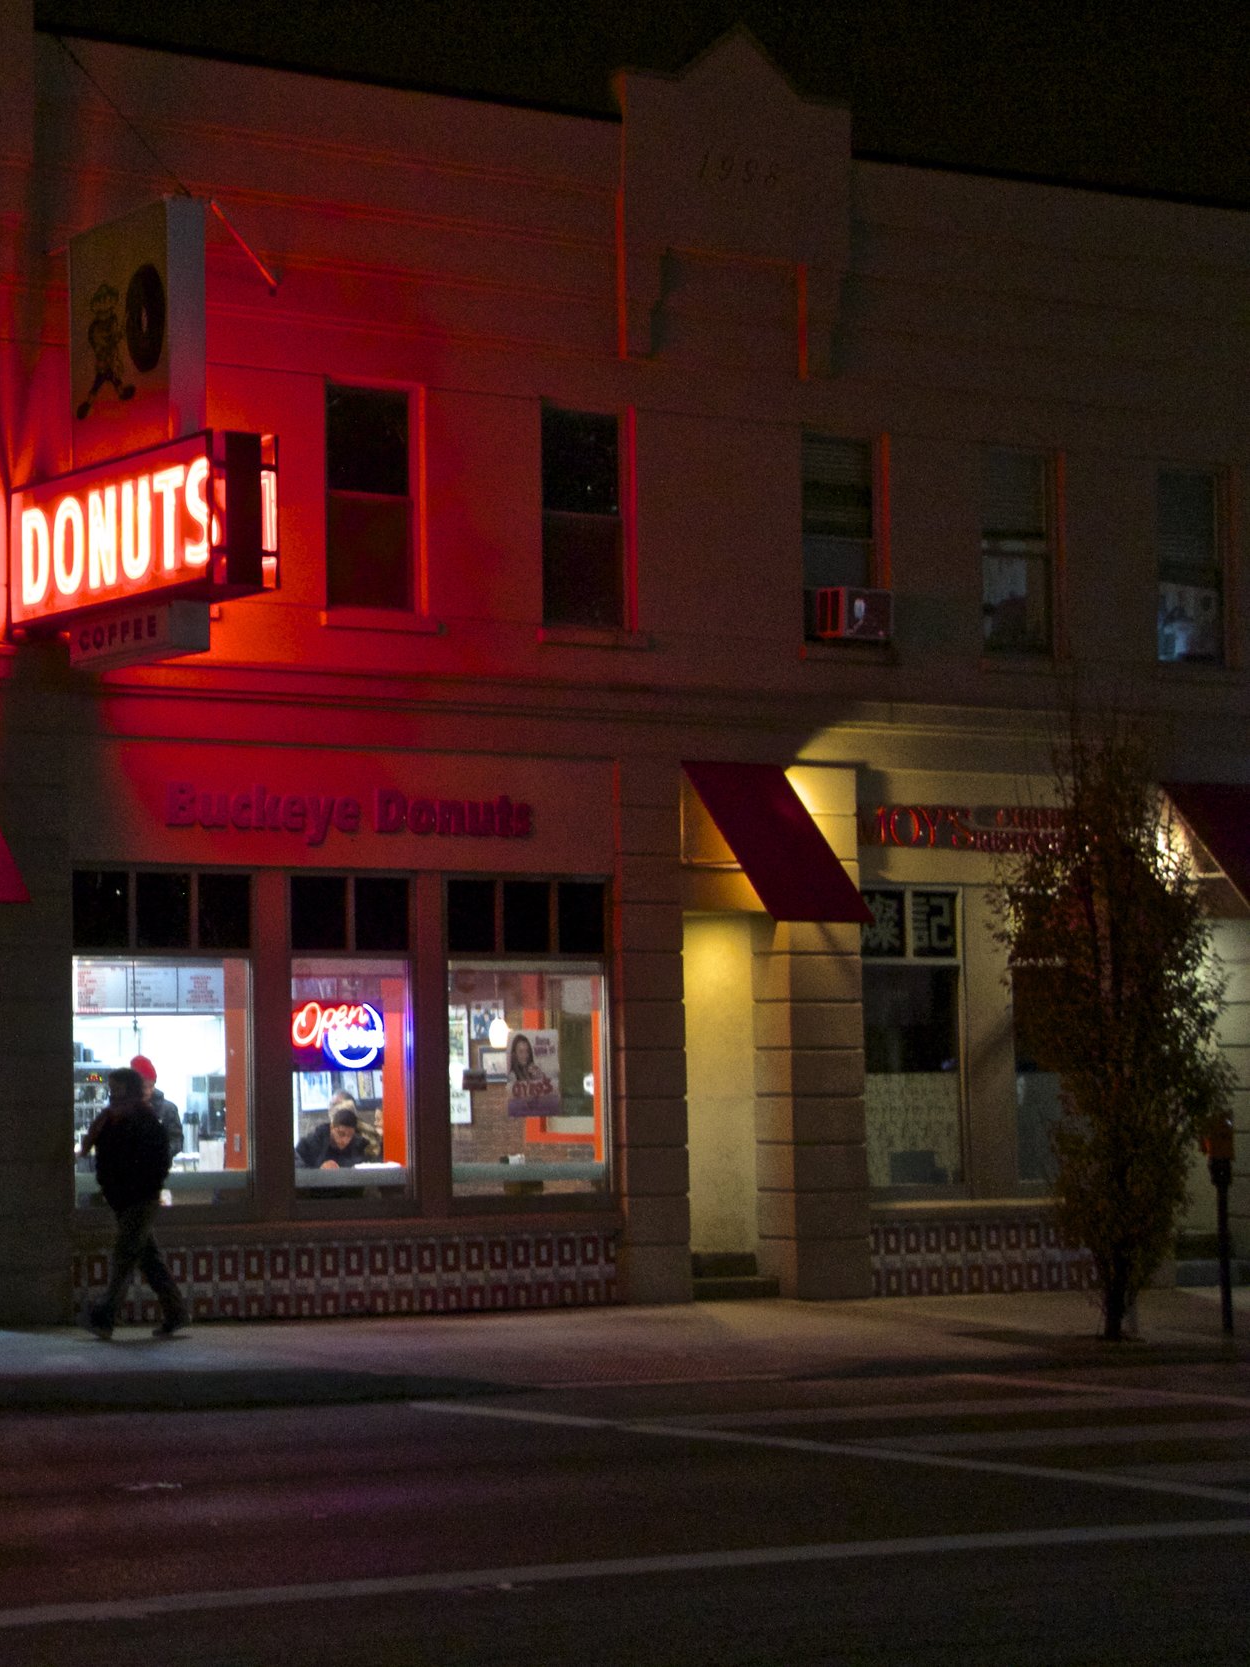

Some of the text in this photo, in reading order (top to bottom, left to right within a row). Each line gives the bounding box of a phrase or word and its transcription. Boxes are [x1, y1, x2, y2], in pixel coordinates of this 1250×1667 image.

[21, 456, 221, 605] DONUTS
[79, 615, 156, 651] COFFEE
[166, 780, 532, 845] Buckeye Donuts
[292, 1001, 369, 1048] Open
